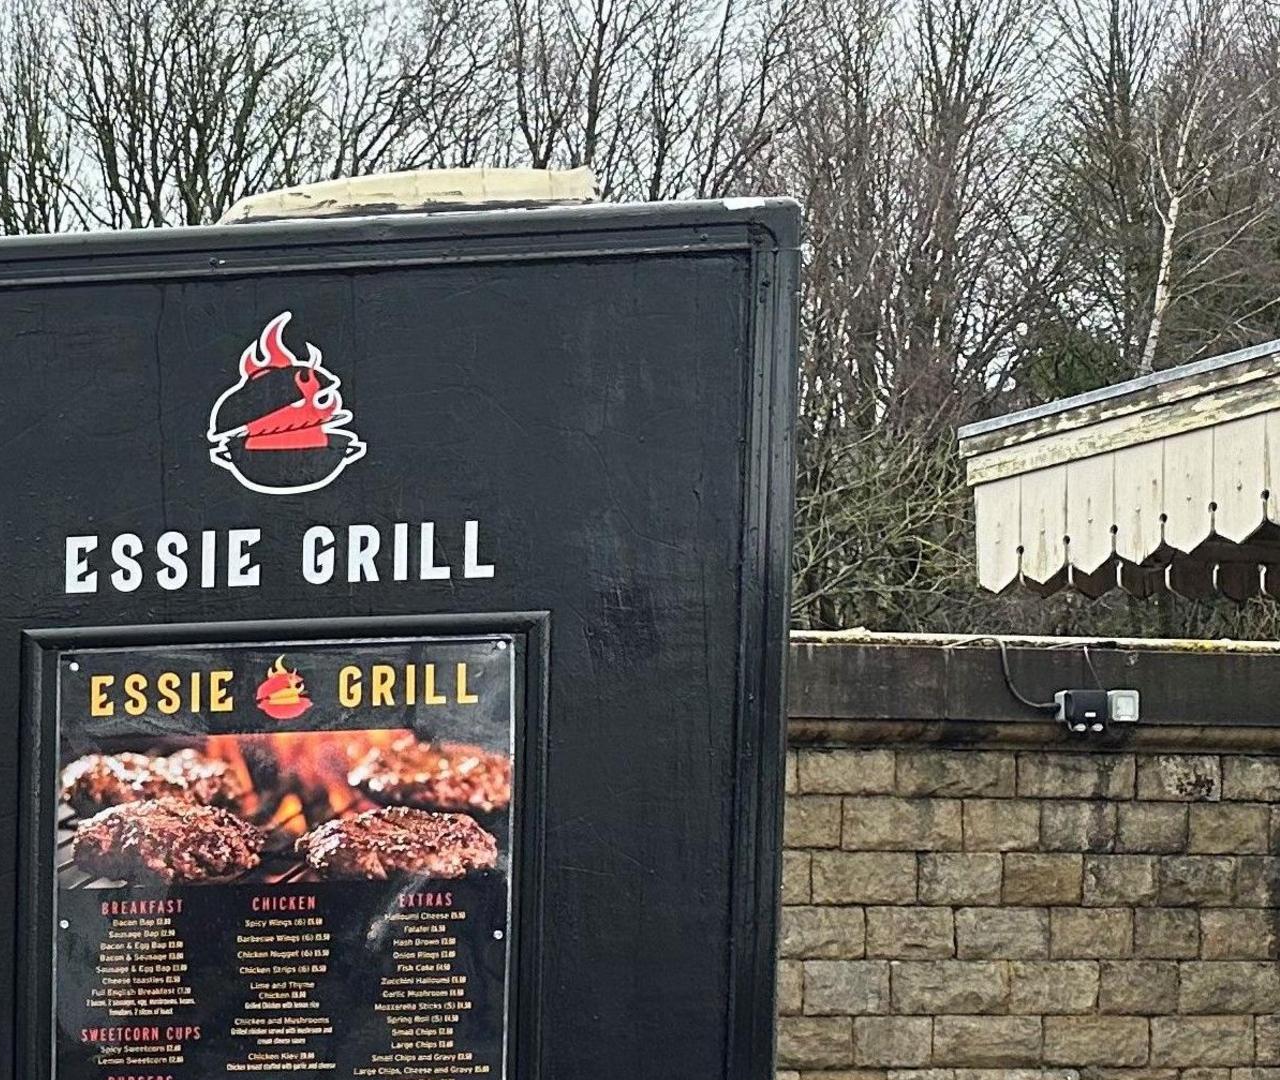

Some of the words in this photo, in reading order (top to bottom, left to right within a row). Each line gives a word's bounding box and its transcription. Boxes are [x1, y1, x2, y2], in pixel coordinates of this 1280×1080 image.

[65, 528, 260, 594] ESSIE
[302, 520, 494, 585] GRILL
[89, 670, 234, 717] ESSIE
[338, 662, 479, 709] GRILL
[252, 896, 316, 911] CHICKEN
[400, 892, 452, 907] EXTRAS
[102, 900, 182, 915] BREAKFAST
[81, 1027, 159, 1042] SWEETCORN
[166, 1026, 201, 1040] CUPS
